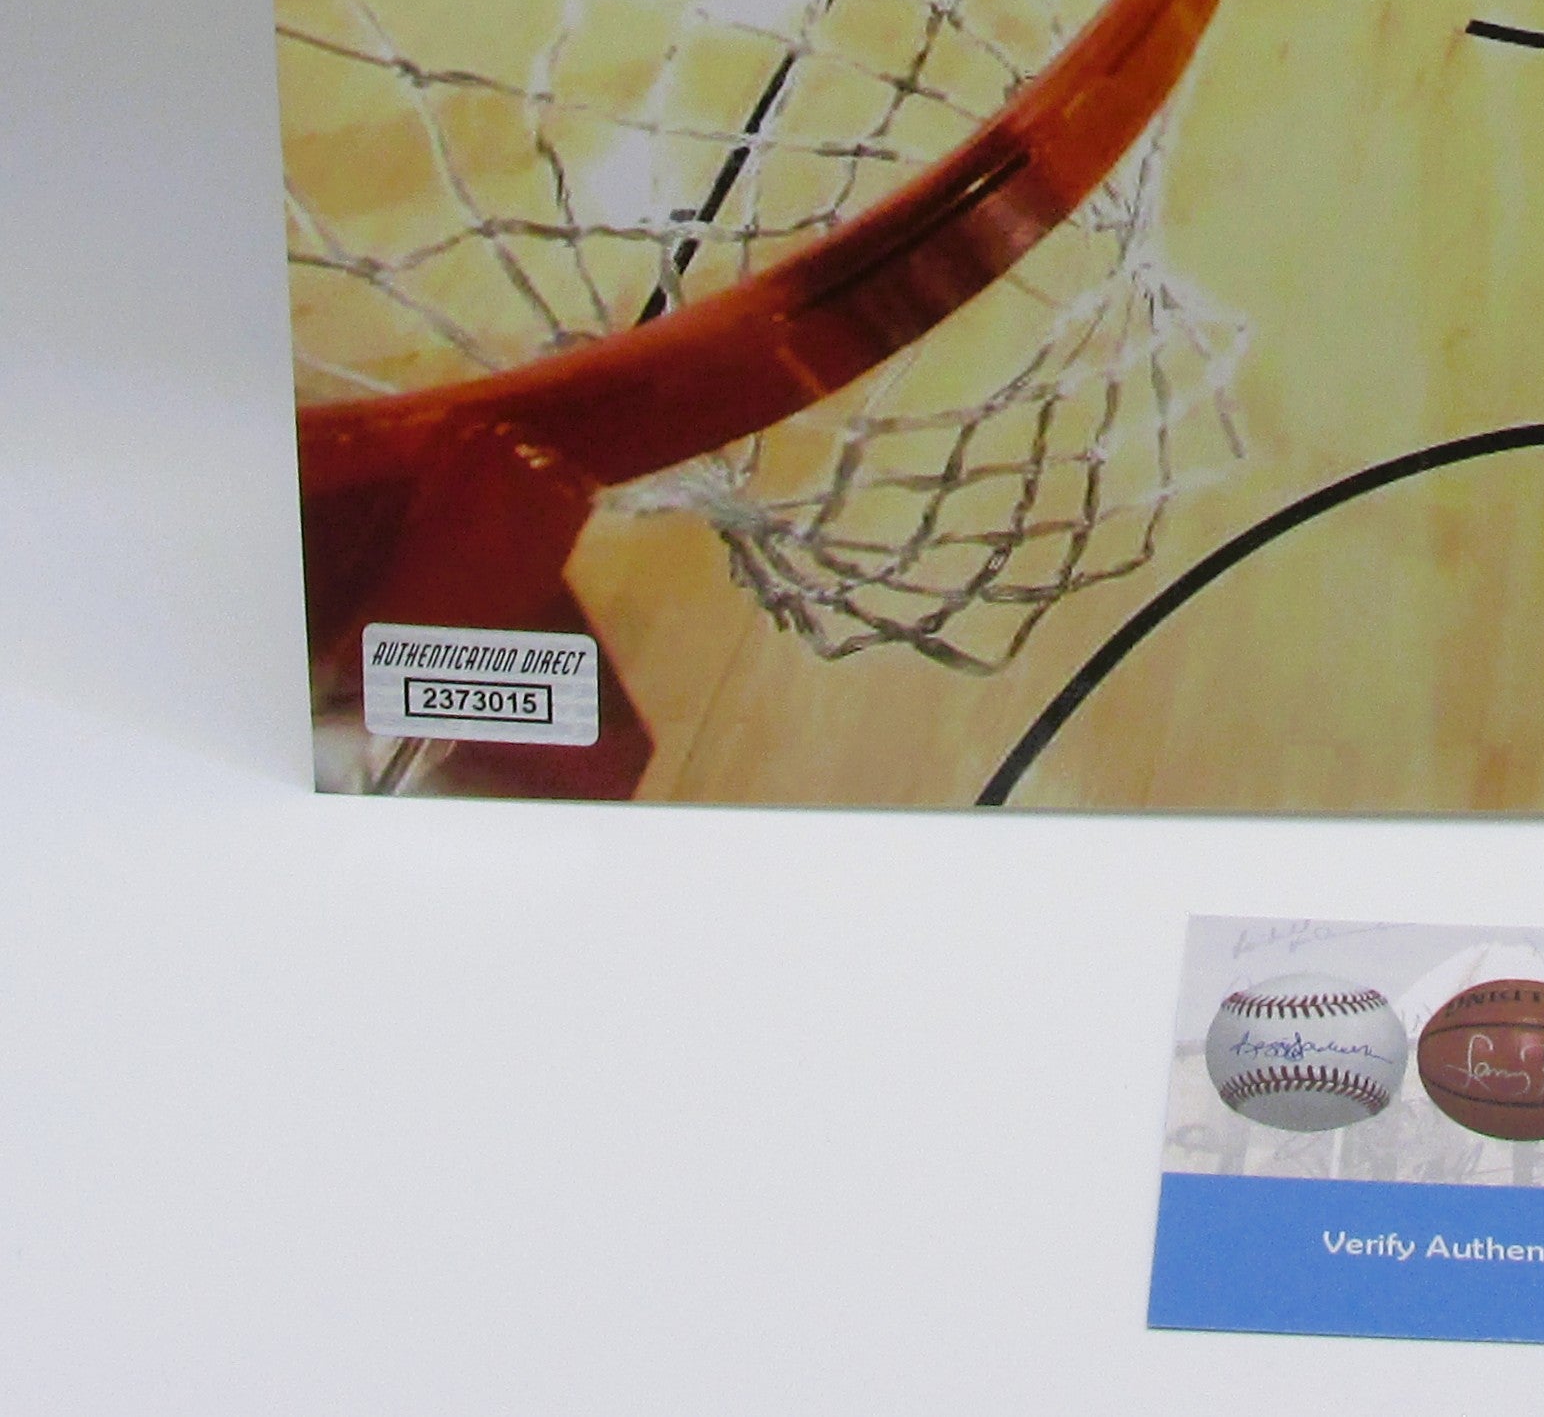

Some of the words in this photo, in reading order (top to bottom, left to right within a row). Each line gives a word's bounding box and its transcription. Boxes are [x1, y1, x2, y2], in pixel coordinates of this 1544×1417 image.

[372, 641, 518, 673] AUTHENTICATION
[521, 649, 586, 675] DIRECT
[422, 687, 538, 715] 2373015
[1322, 1230, 1416, 1261] Verify
